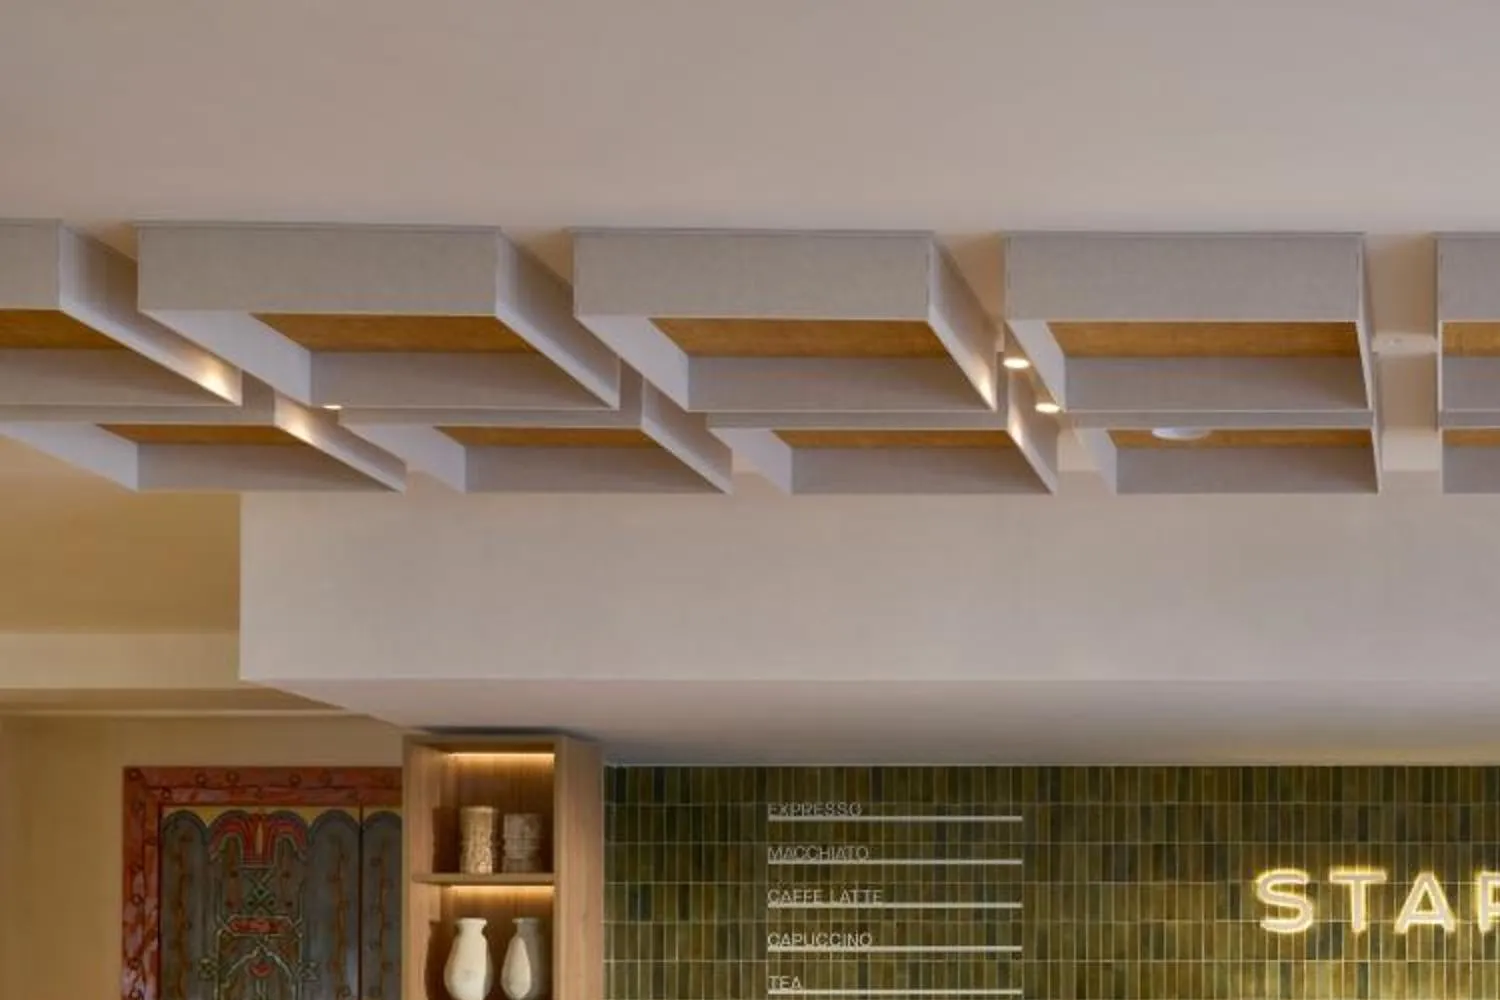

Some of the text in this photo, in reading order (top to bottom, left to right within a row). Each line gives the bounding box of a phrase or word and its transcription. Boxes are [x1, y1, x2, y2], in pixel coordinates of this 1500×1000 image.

[767, 802, 862, 817] EXPRESSO
[767, 845, 870, 860] MACCHIATO
[767, 889, 883, 904] CAFFE LATTE
[767, 932, 873, 947] CAPUCCINO
[768, 975, 803, 990] TEA
